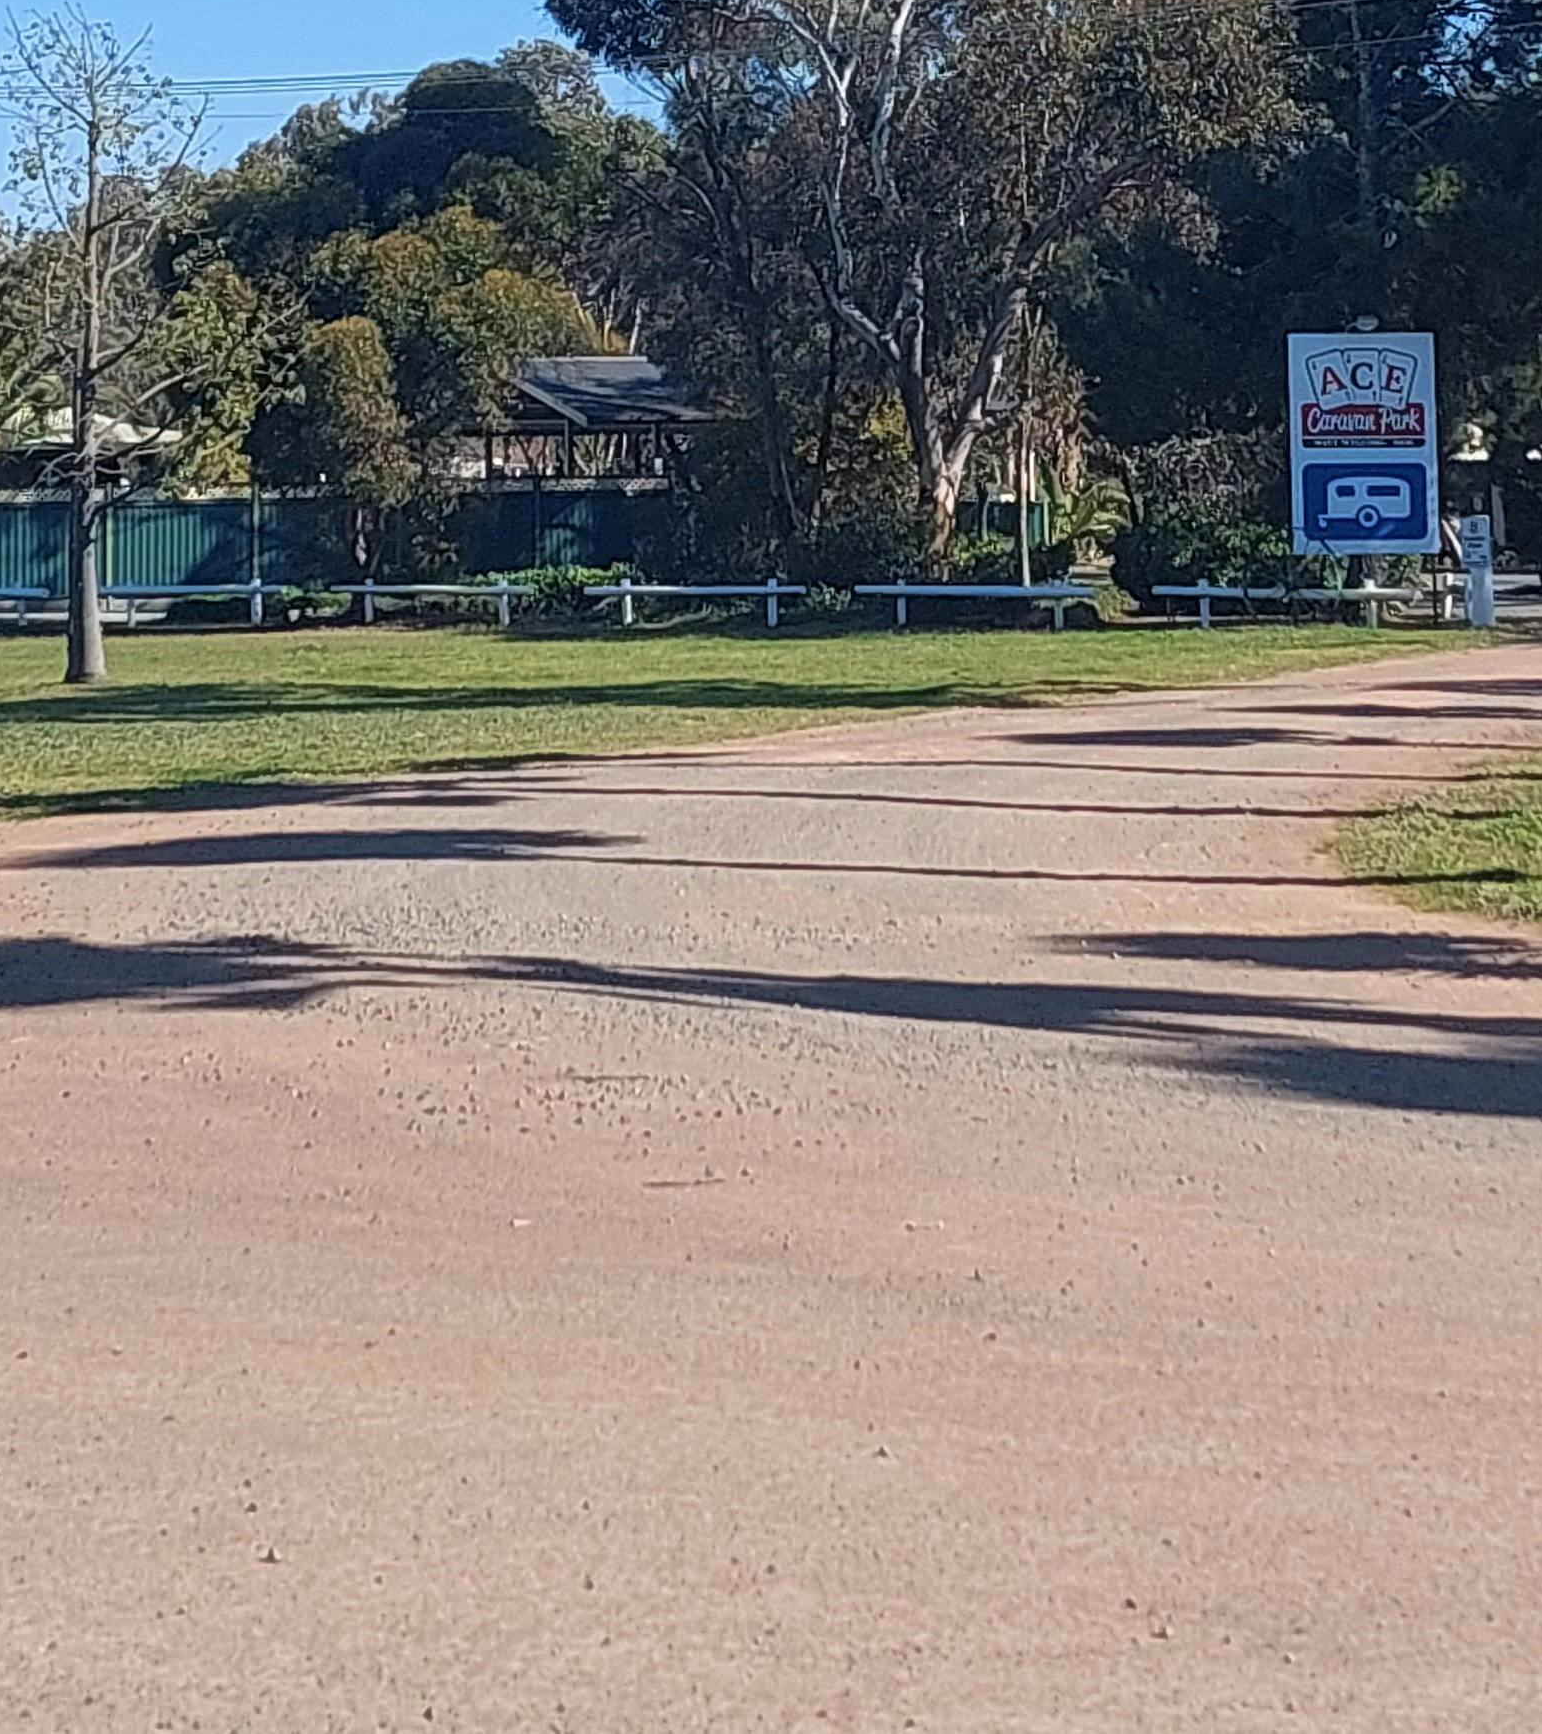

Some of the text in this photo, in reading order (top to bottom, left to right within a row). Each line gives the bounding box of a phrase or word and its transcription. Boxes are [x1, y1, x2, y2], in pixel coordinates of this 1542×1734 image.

[1321, 362, 1407, 396] ACE
[1307, 407, 1421, 434] Caravan Park
